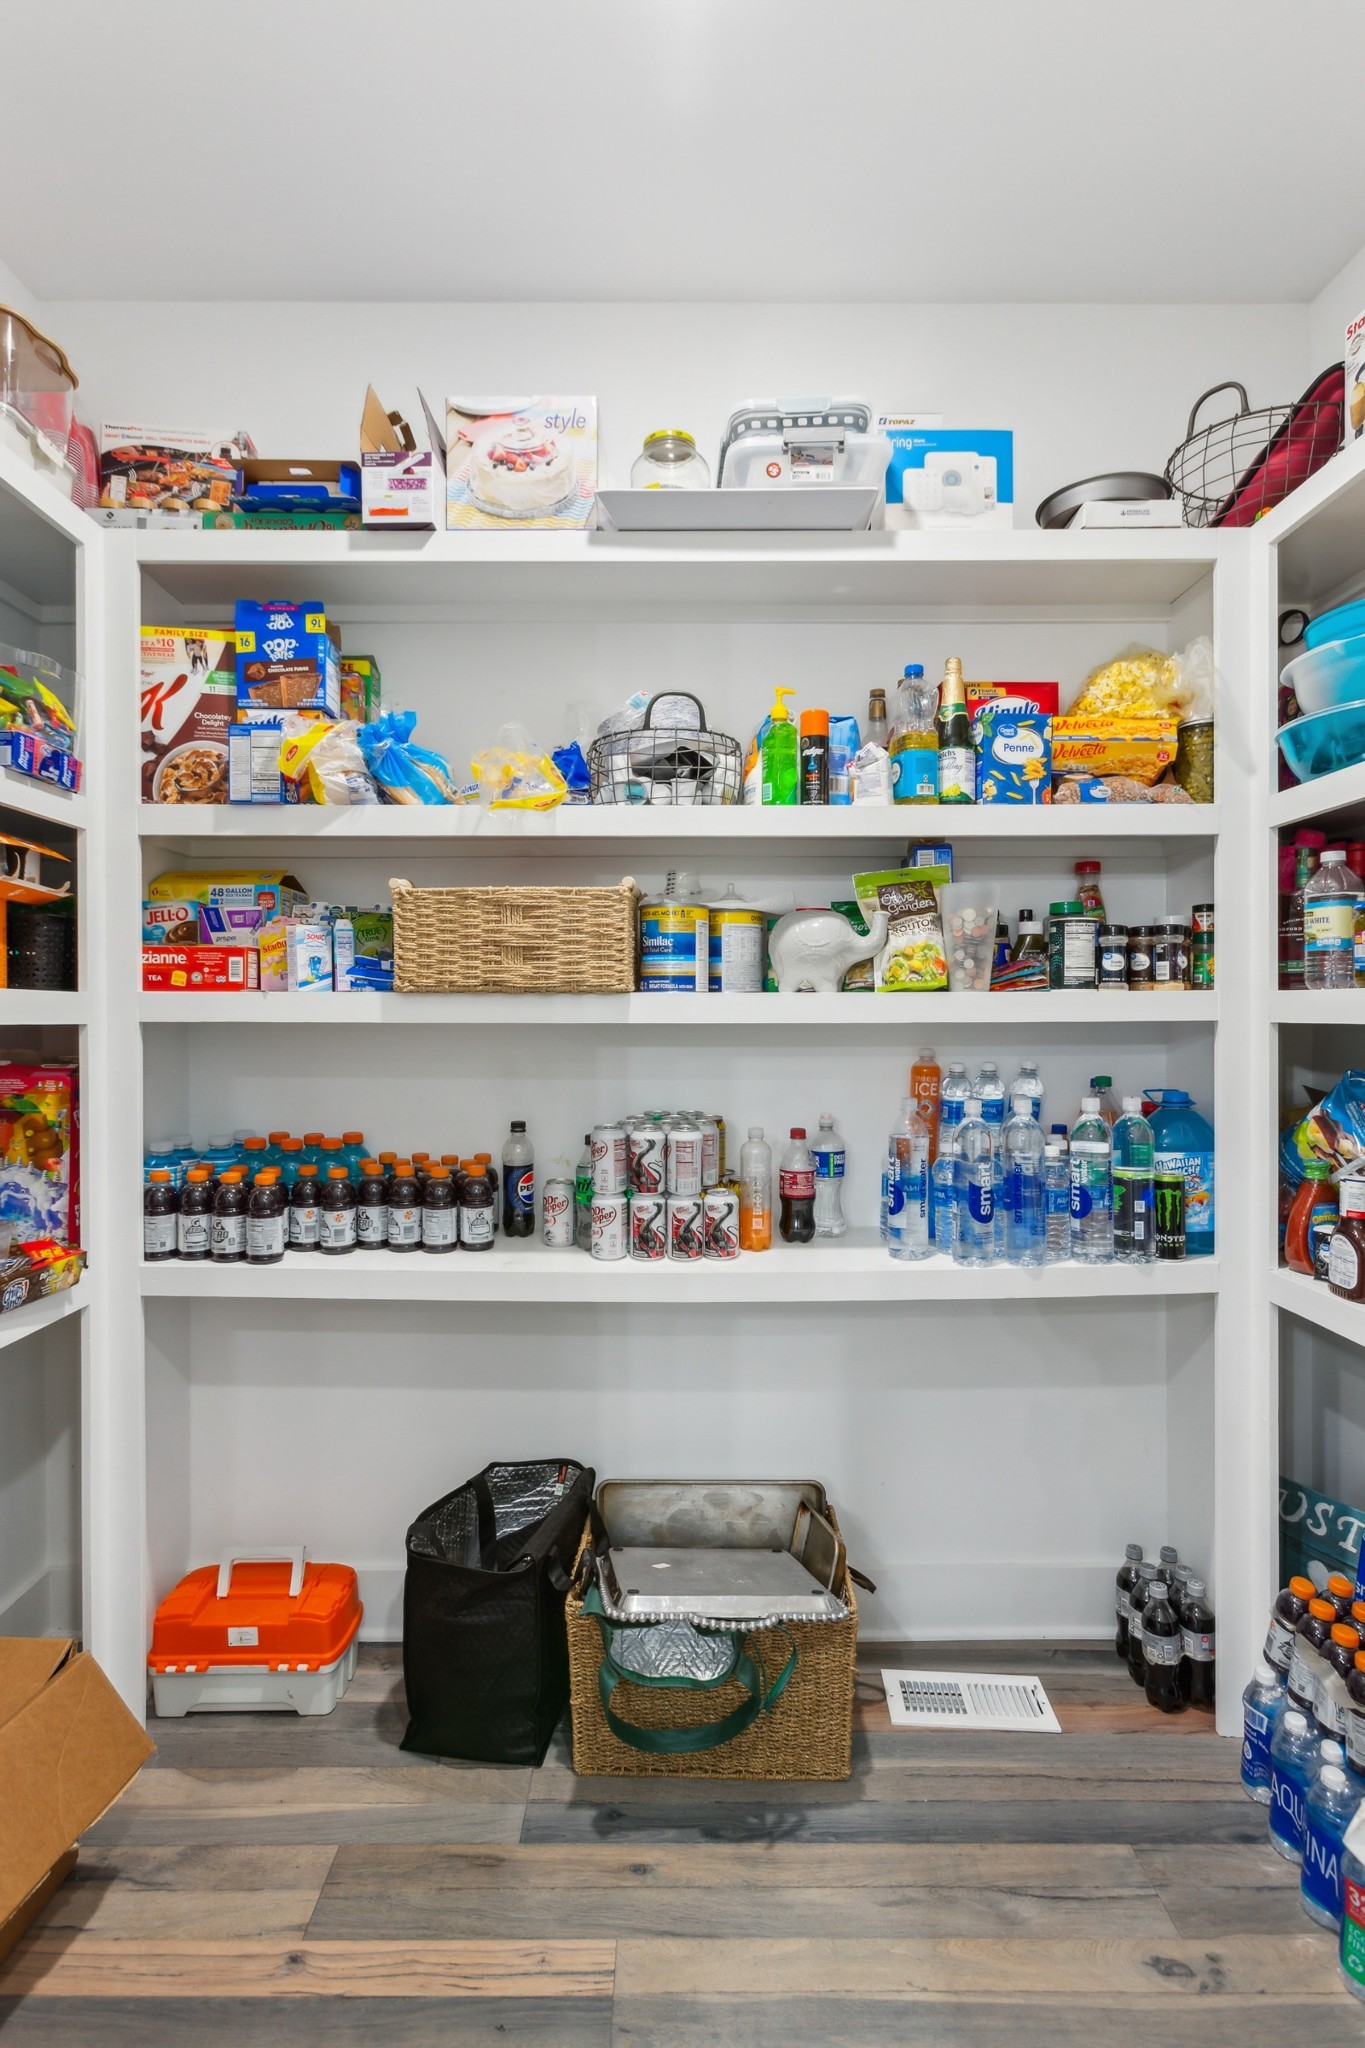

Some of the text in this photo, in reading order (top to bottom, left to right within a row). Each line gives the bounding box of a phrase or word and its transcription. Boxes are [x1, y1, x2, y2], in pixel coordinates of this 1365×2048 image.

[544, 408, 586, 434] style
[892, 436, 912, 450] ring
[311, 618, 322, 628] 16
[154, 628, 186, 636] FAMILY
[156, 638, 174, 648] $10
[240, 638, 250, 647] 16
[194, 712, 232, 722] Chocolatey
[202, 719, 224, 728] Delight
[1056, 720, 1114, 731] Velveeta
[802, 746, 824, 757] edge
[1004, 743, 1034, 752] Penne
[1052, 743, 1106, 760] Velveeta
[210, 888, 224, 897] 48
[888, 899, 935, 915] Garden
[361, 927, 381, 937] TRUE
[643, 936, 674, 947] Similac
[142, 950, 187, 964] zianne
[915, 1082, 938, 1096] ICE
[1154, 1156, 1202, 1172] HAWAIIAN
[978, 1162, 991, 1215] smart
[1070, 1157, 1080, 1211] smart
[214, 1220, 222, 1228] G
